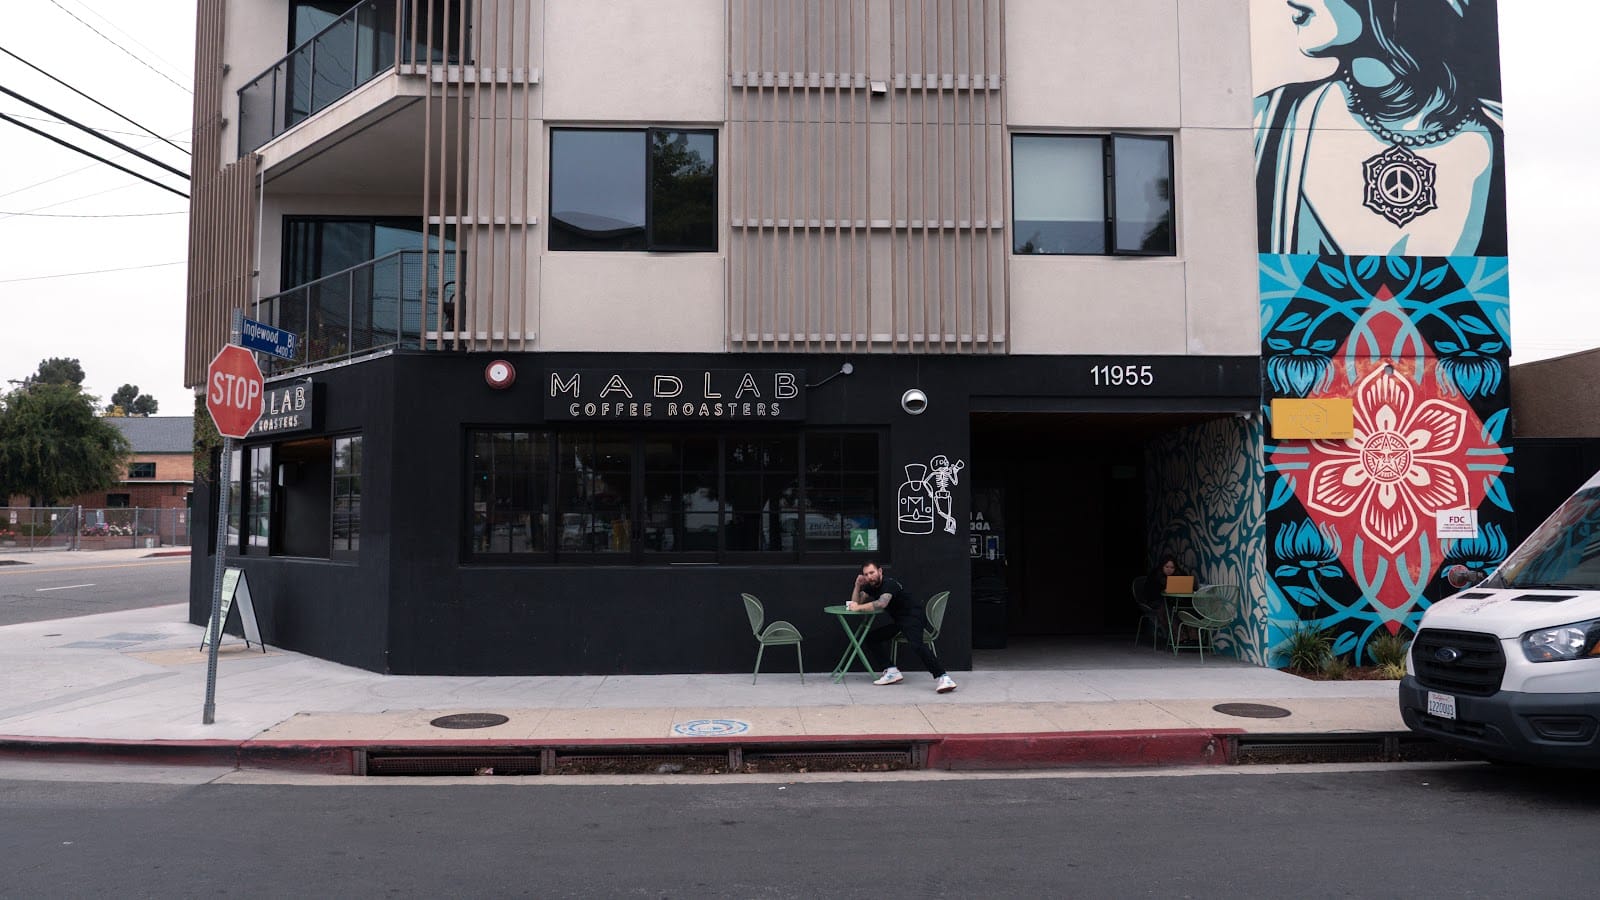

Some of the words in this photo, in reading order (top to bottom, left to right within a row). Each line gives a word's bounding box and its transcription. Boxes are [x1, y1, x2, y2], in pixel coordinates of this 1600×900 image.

[243, 320, 279, 344] Inglewood
[275, 345, 288, 357] 4400
[1090, 365, 1153, 386] 11955
[212, 371, 259, 410] STOP
[569, 403, 652, 417] COFFEE
[668, 403, 781, 417] ROASTERS
[259, 415, 298, 432] ROASTERS
[854, 534, 865, 546] A
